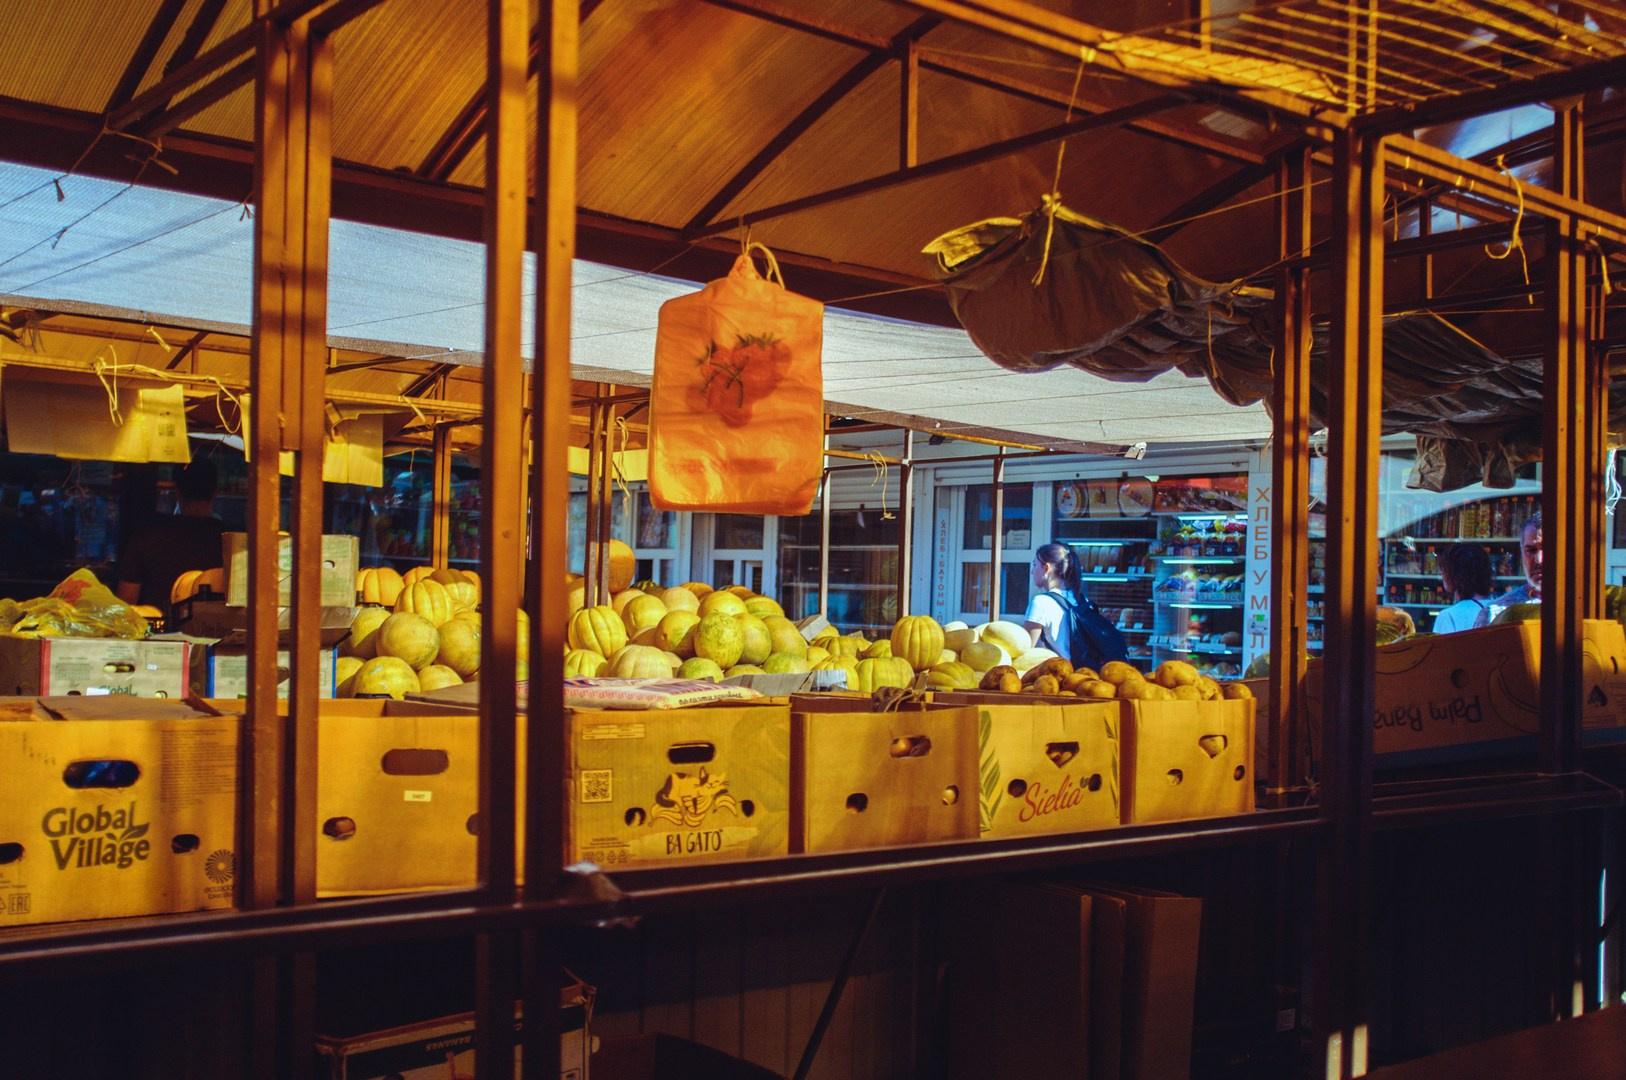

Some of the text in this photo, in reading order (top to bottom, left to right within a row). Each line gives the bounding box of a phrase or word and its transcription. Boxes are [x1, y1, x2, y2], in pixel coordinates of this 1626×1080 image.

[939, 522, 947, 552] ХЛЕБ
[1254, 487, 1271, 560] ХЛЕБ
[936, 561, 945, 606] БАТОНЫ
[1252, 570, 1267, 586] У
[1374, 695, 1482, 732] Palm Bana
[1018, 774, 1082, 823] Sielia
[42, 801, 150, 838] Global
[50, 834, 151, 870] Village
[666, 830, 722, 855] BA GATO
[425, 1034, 472, 1052] BANANAS
